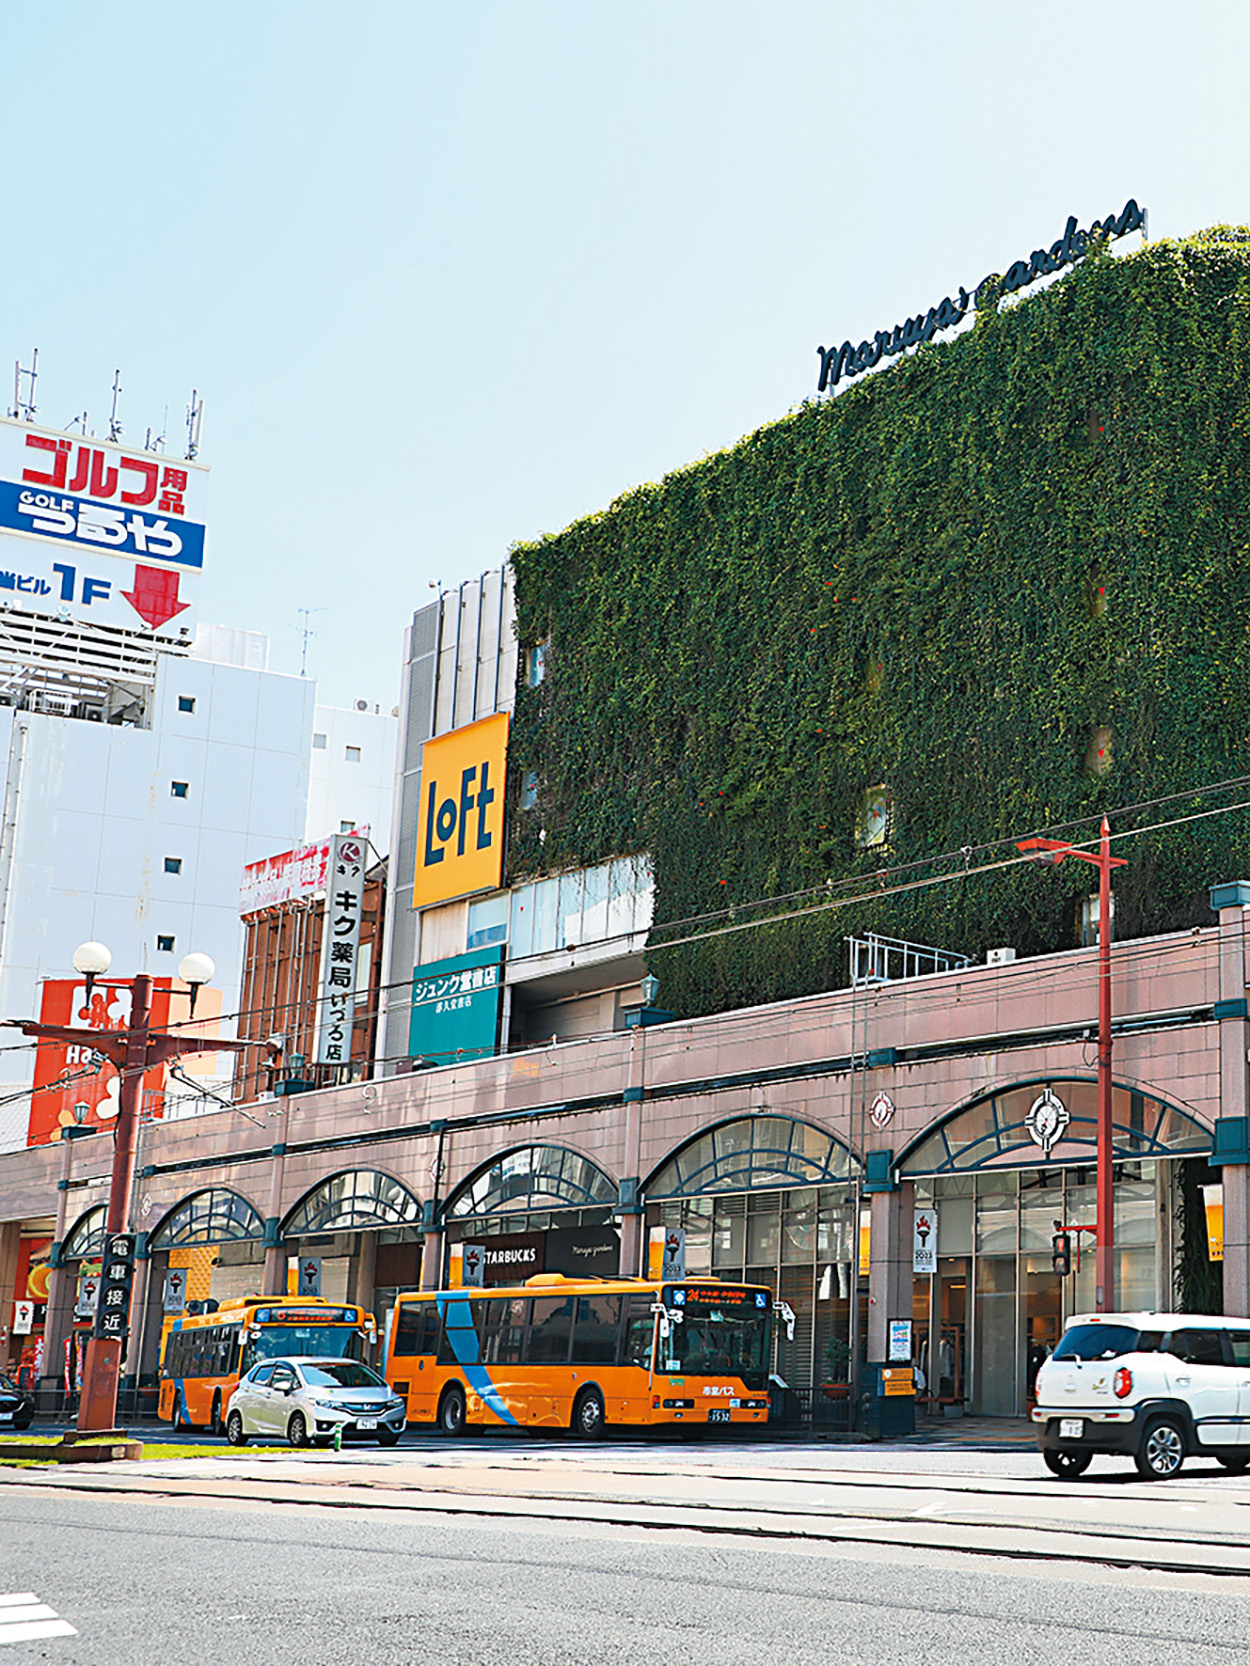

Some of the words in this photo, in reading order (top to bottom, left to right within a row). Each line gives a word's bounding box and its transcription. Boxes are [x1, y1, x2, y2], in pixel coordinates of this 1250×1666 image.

[19, 491, 74, 512] GOLF
[18, 502, 183, 557] つるや
[53, 562, 112, 605] 1F
